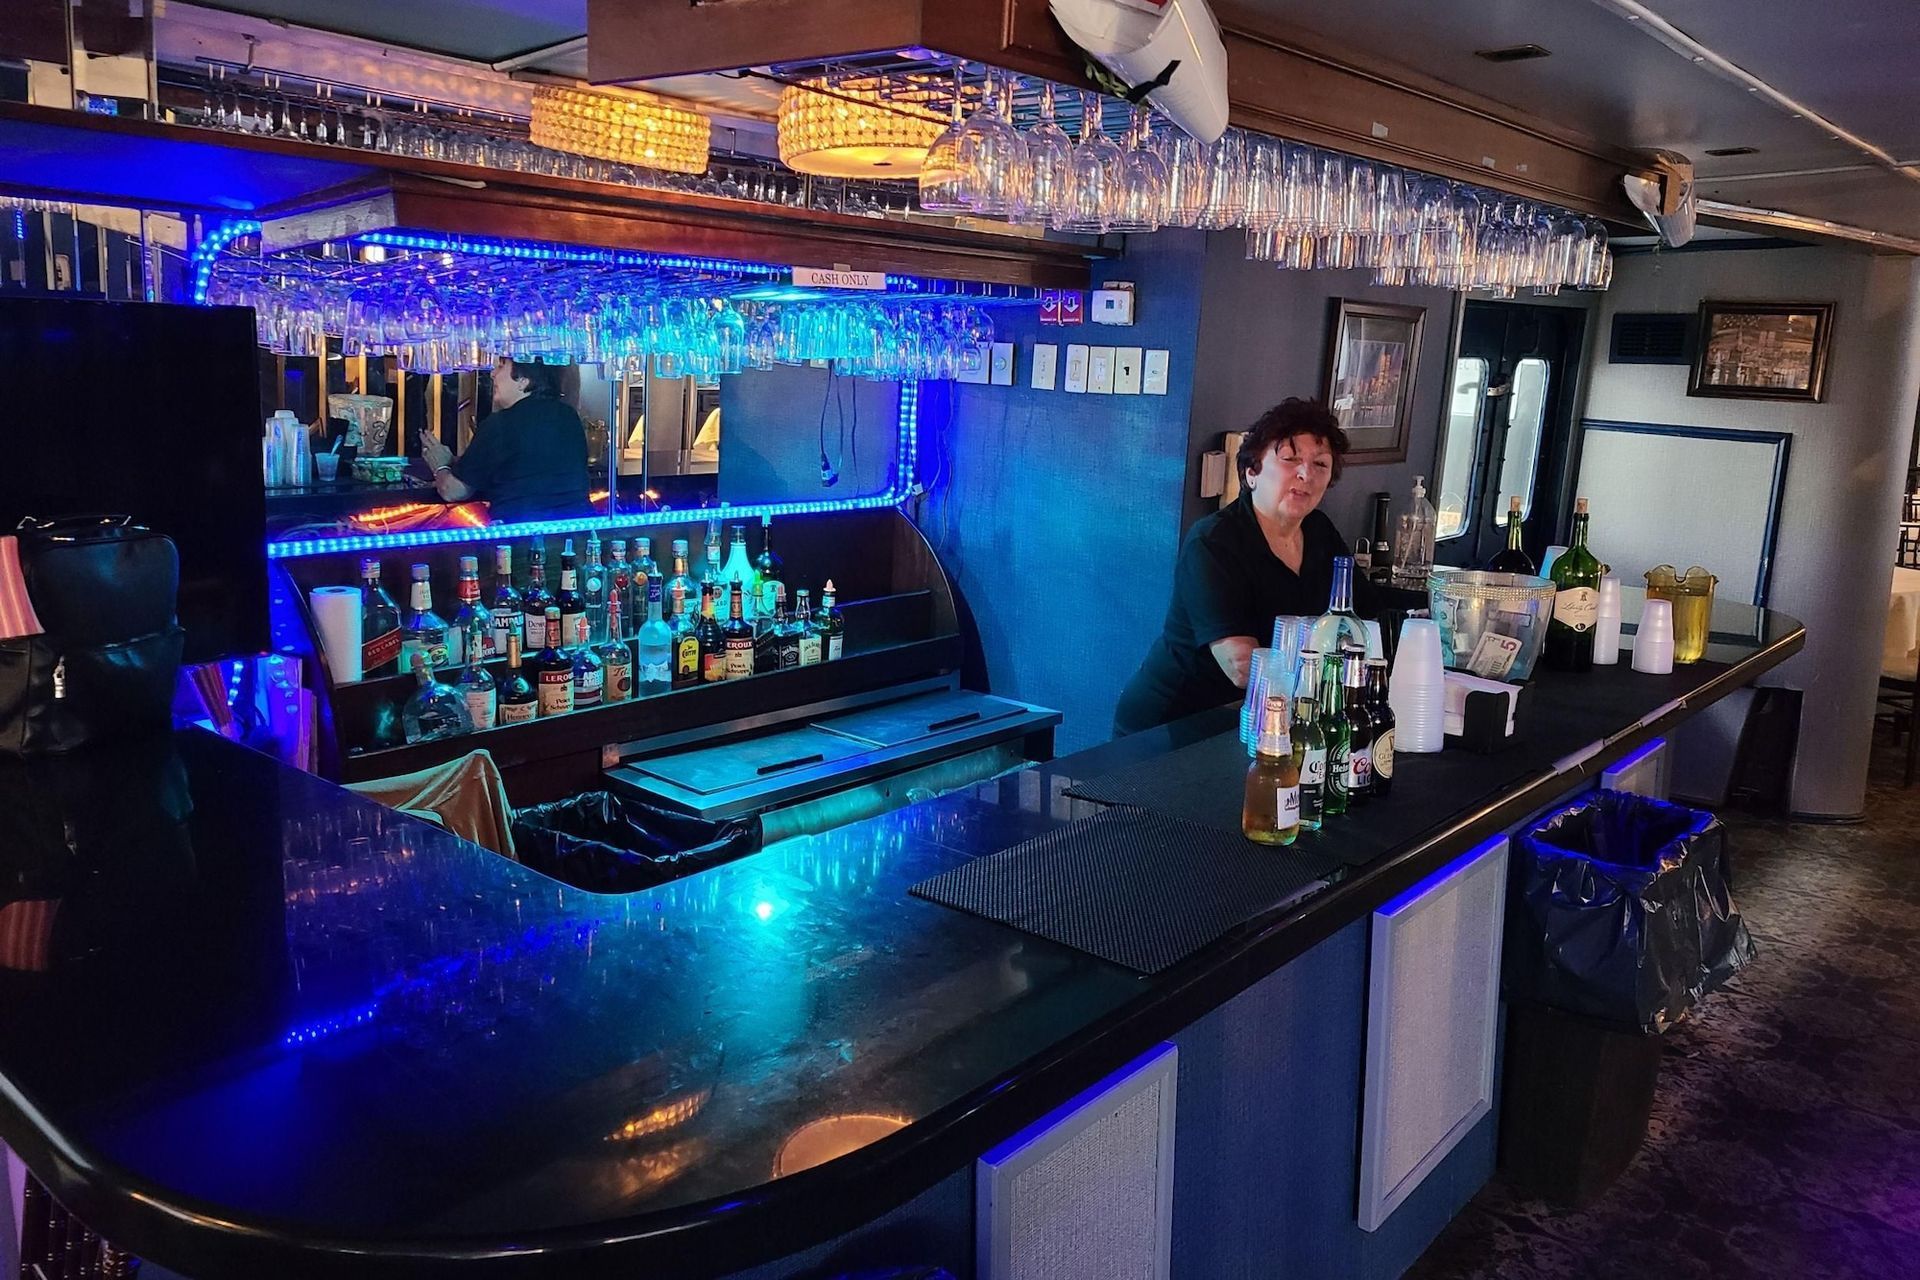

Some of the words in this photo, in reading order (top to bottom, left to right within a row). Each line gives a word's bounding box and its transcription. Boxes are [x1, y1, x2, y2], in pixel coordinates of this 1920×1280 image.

[811, 272, 839, 285] CASH
[841, 273, 869, 286] ONLY
[367, 647, 381, 657] RED
[381, 638, 400, 650] LABEL
[1500, 640, 1517, 651] 5
